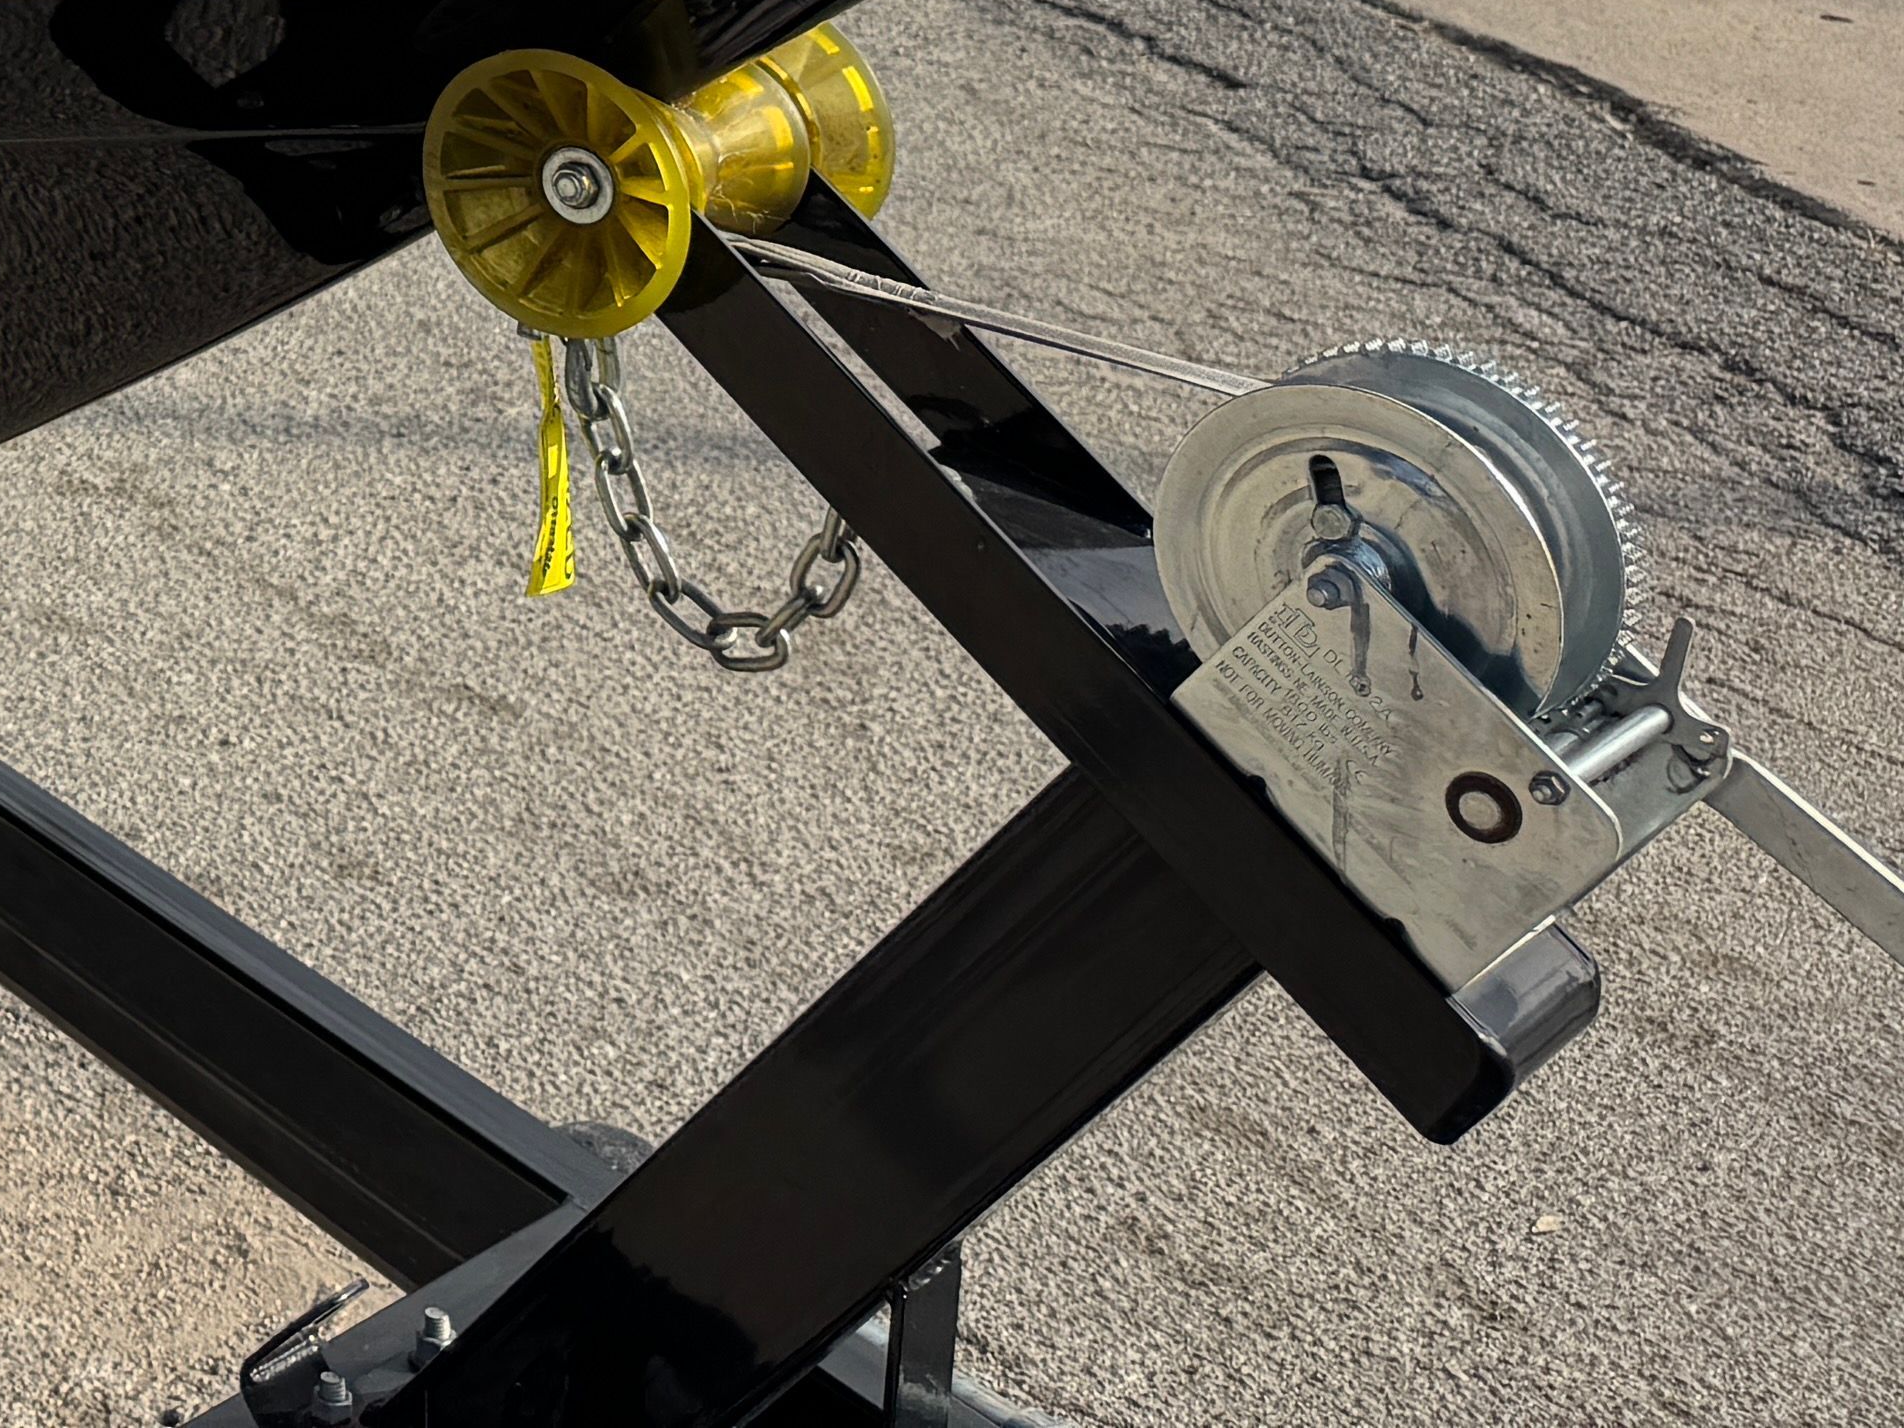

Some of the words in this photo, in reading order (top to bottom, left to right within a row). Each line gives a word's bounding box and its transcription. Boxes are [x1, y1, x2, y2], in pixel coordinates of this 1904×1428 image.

[1215, 658, 1242, 686] NOT
[1239, 683, 1265, 710] FOR
[1261, 707, 1305, 751] MOVING
[1231, 644, 1281, 696] CAPACITY
